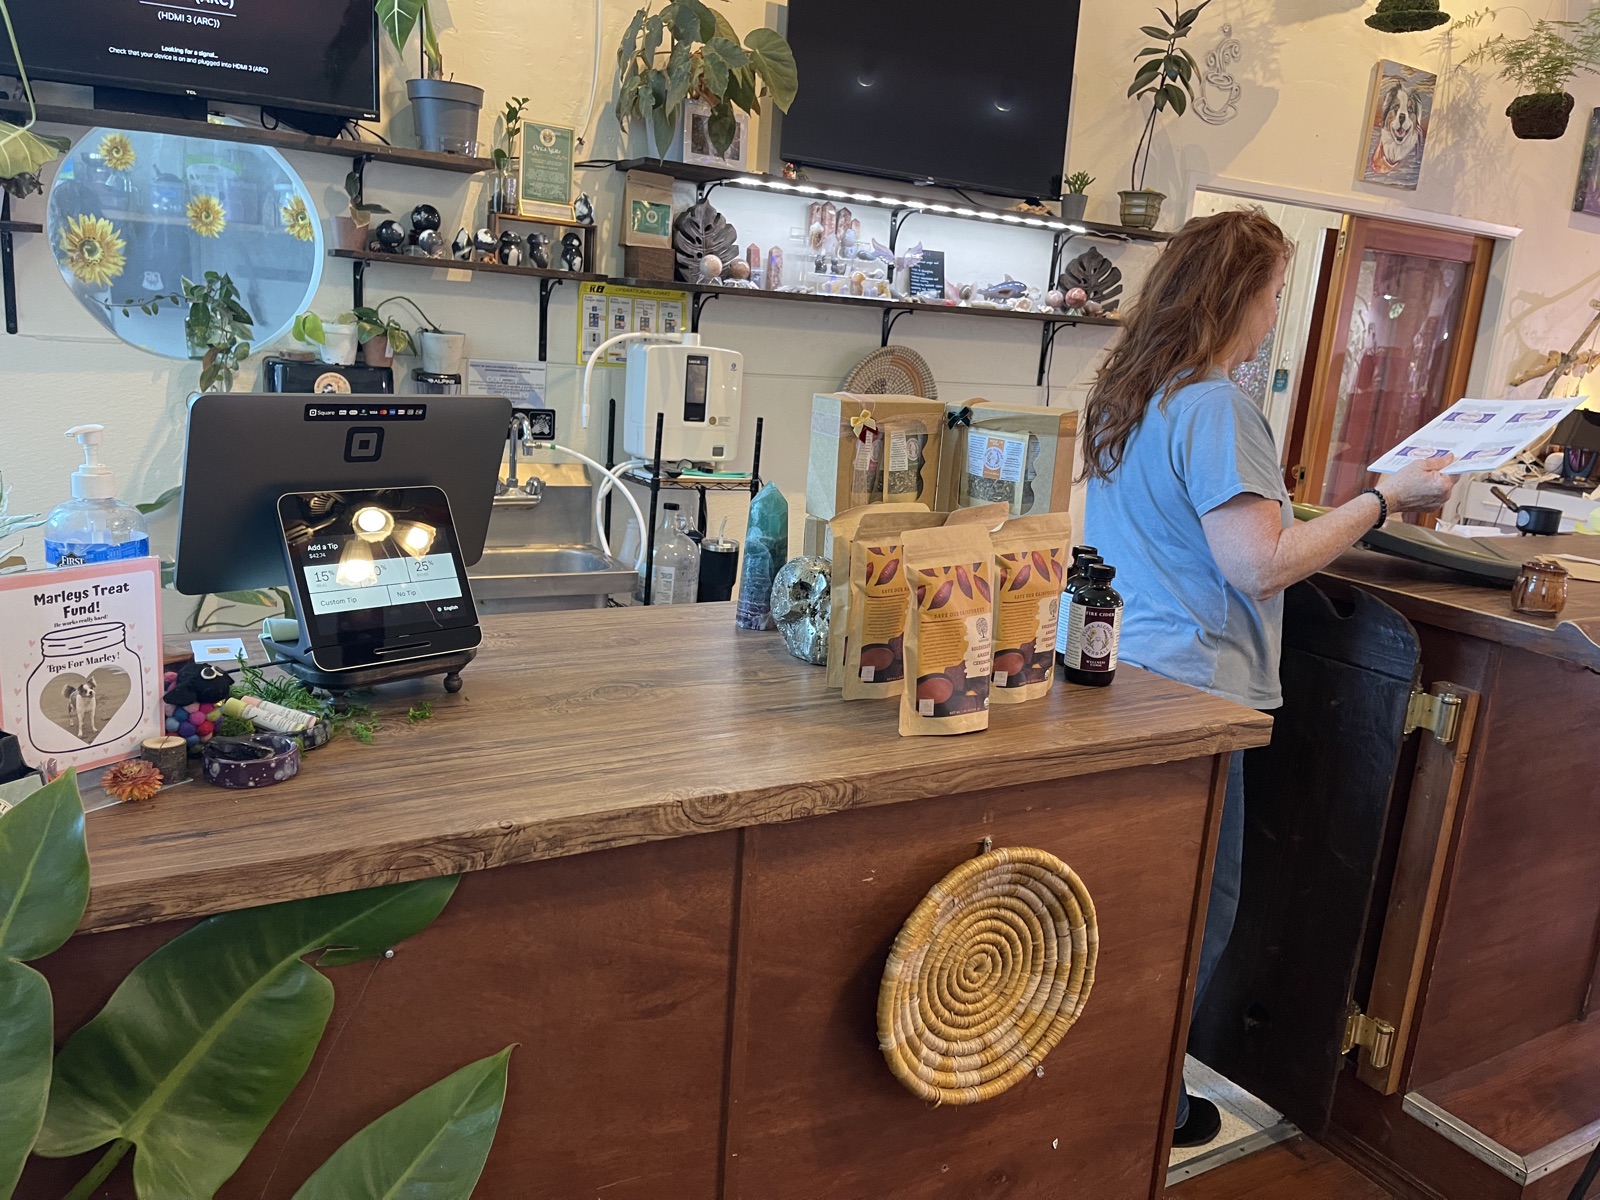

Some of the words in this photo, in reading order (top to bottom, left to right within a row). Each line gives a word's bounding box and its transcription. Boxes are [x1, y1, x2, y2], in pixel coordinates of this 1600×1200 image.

[158, 11, 184, 22] (HDMI
[186, 15, 192, 23] 3
[194, 16, 220, 28] (ARC))
[161, 46, 184, 54] Looking
[198, 59, 220, 67] plugged
[253, 66, 268, 74] (ARC)
[615, 287, 652, 295] OPERATIONAL
[61, 555, 84, 565] FIRST
[415, 560, 434, 571] 25%
[315, 570, 335, 582] 15%
[34, 589, 88, 606] Marleys
[92, 583, 129, 596] Treat
[321, 597, 345, 607] Custom
[63, 602, 100, 618] Fund!
[68, 659, 84, 668] For
[86, 652, 120, 665] Marley!
